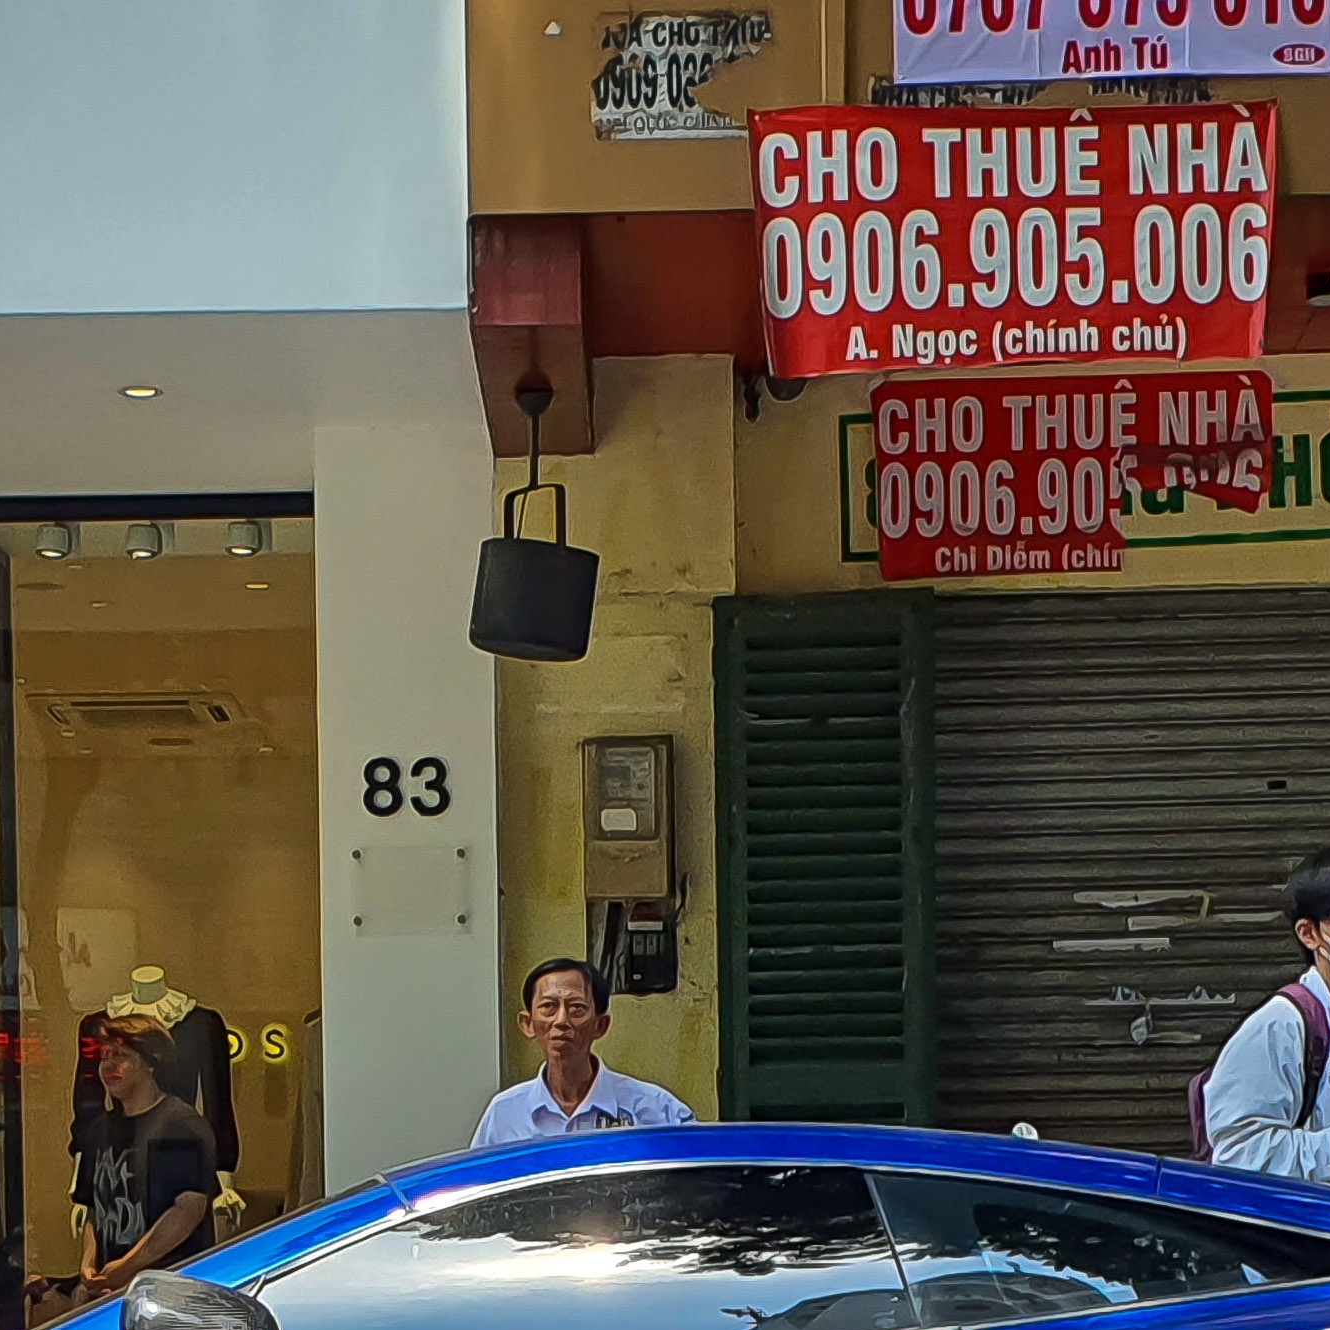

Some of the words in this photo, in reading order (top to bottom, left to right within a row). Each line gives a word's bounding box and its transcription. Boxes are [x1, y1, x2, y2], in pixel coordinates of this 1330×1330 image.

[1062, 36, 1122, 74] Anh
[1131, 34, 1170, 71] Tú
[759, 127, 899, 208] CHO
[922, 106, 1101, 199] THUÊ
[1127, 103, 1268, 196] NHÀ
[762, 203, 1269, 320] 0906.905.006
[845, 325, 880, 362] A.
[892, 323, 979, 365] Ngọc
[992, 318, 1100, 363] (chính
[1111, 311, 1188, 360] chủ)
[878, 395, 985, 456] CHO
[1001, 378, 1138, 452] THUÊ
[1158, 374, 1266, 447] NHÀ
[362, 756, 452, 818] 83
